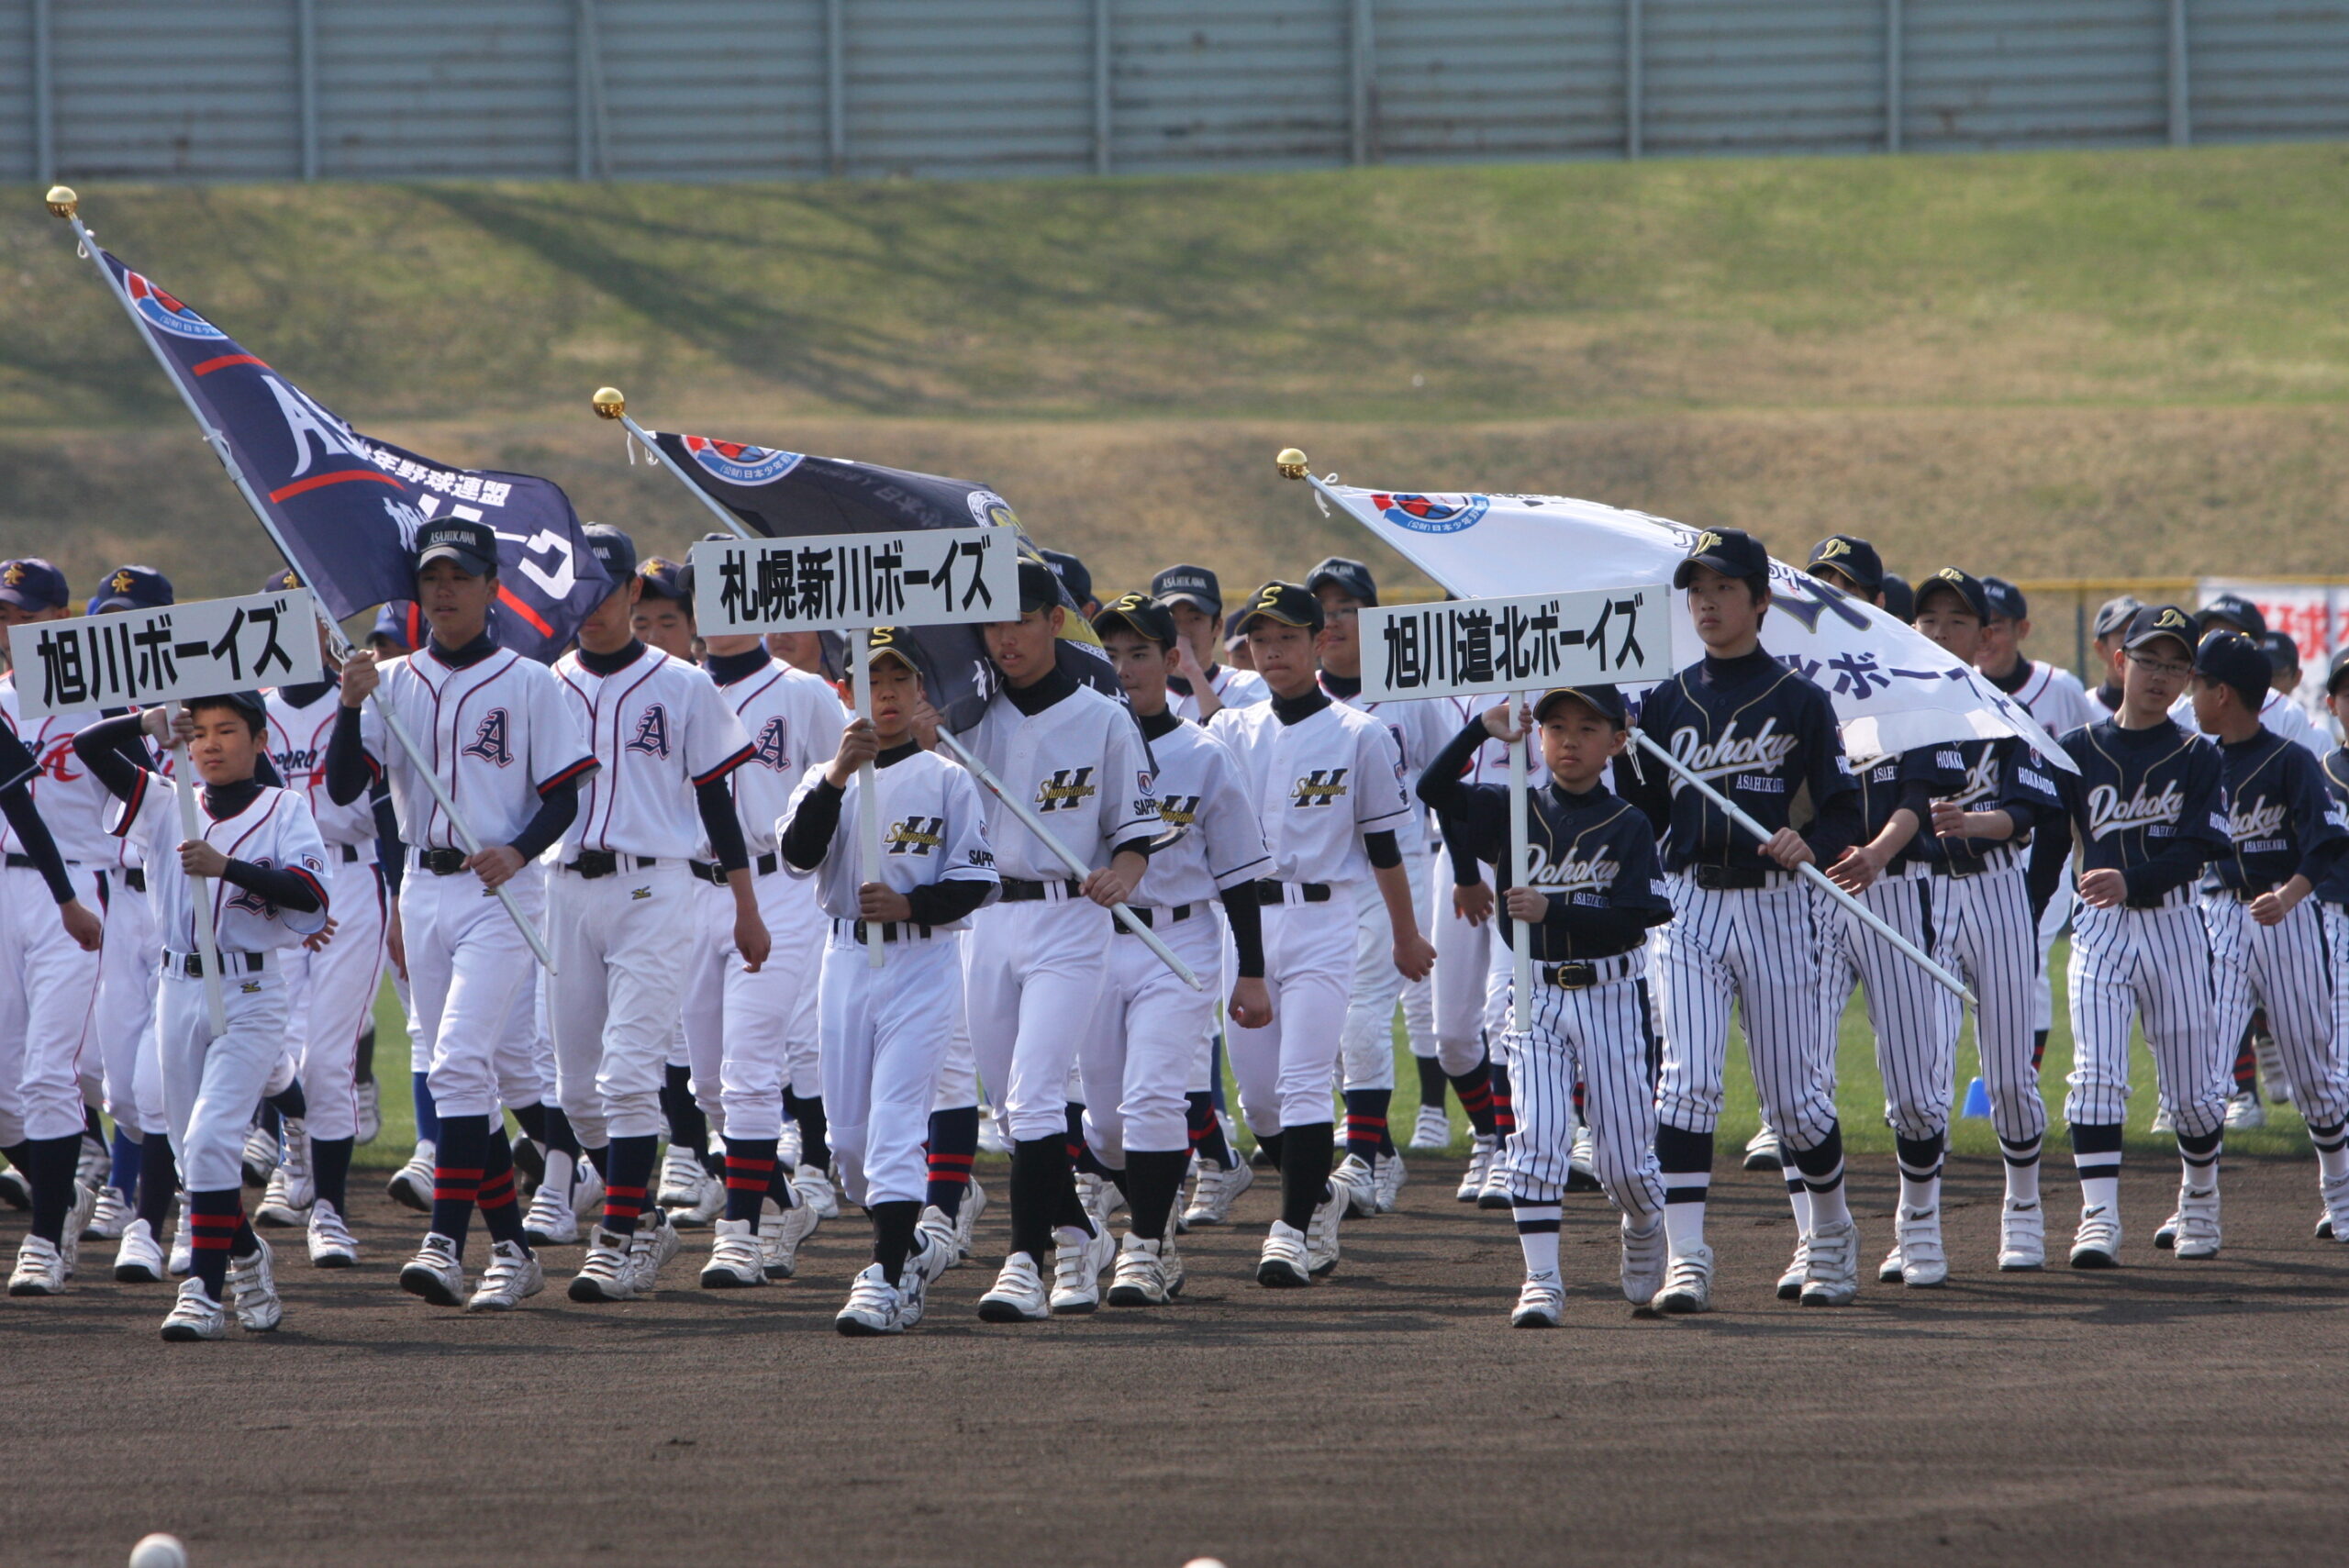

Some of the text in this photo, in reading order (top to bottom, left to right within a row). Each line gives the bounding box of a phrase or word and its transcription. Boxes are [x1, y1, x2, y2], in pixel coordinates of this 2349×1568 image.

[429, 529, 476, 546] ASAHIKAWA
[719, 534, 993, 625] 札幌新川ボーイズ
[1118, 595, 1143, 612] S
[1257, 586, 1283, 609] S
[37, 598, 293, 708] 旭川ボーイズ
[1384, 592, 1644, 692] 旭川道北ボーイズ
[462, 707, 514, 768] A
[625, 703, 670, 760] A
[751, 716, 791, 773] A
[1669, 717, 1798, 782] Dohoku
[2019, 766, 2057, 797] HOKKAIDO
